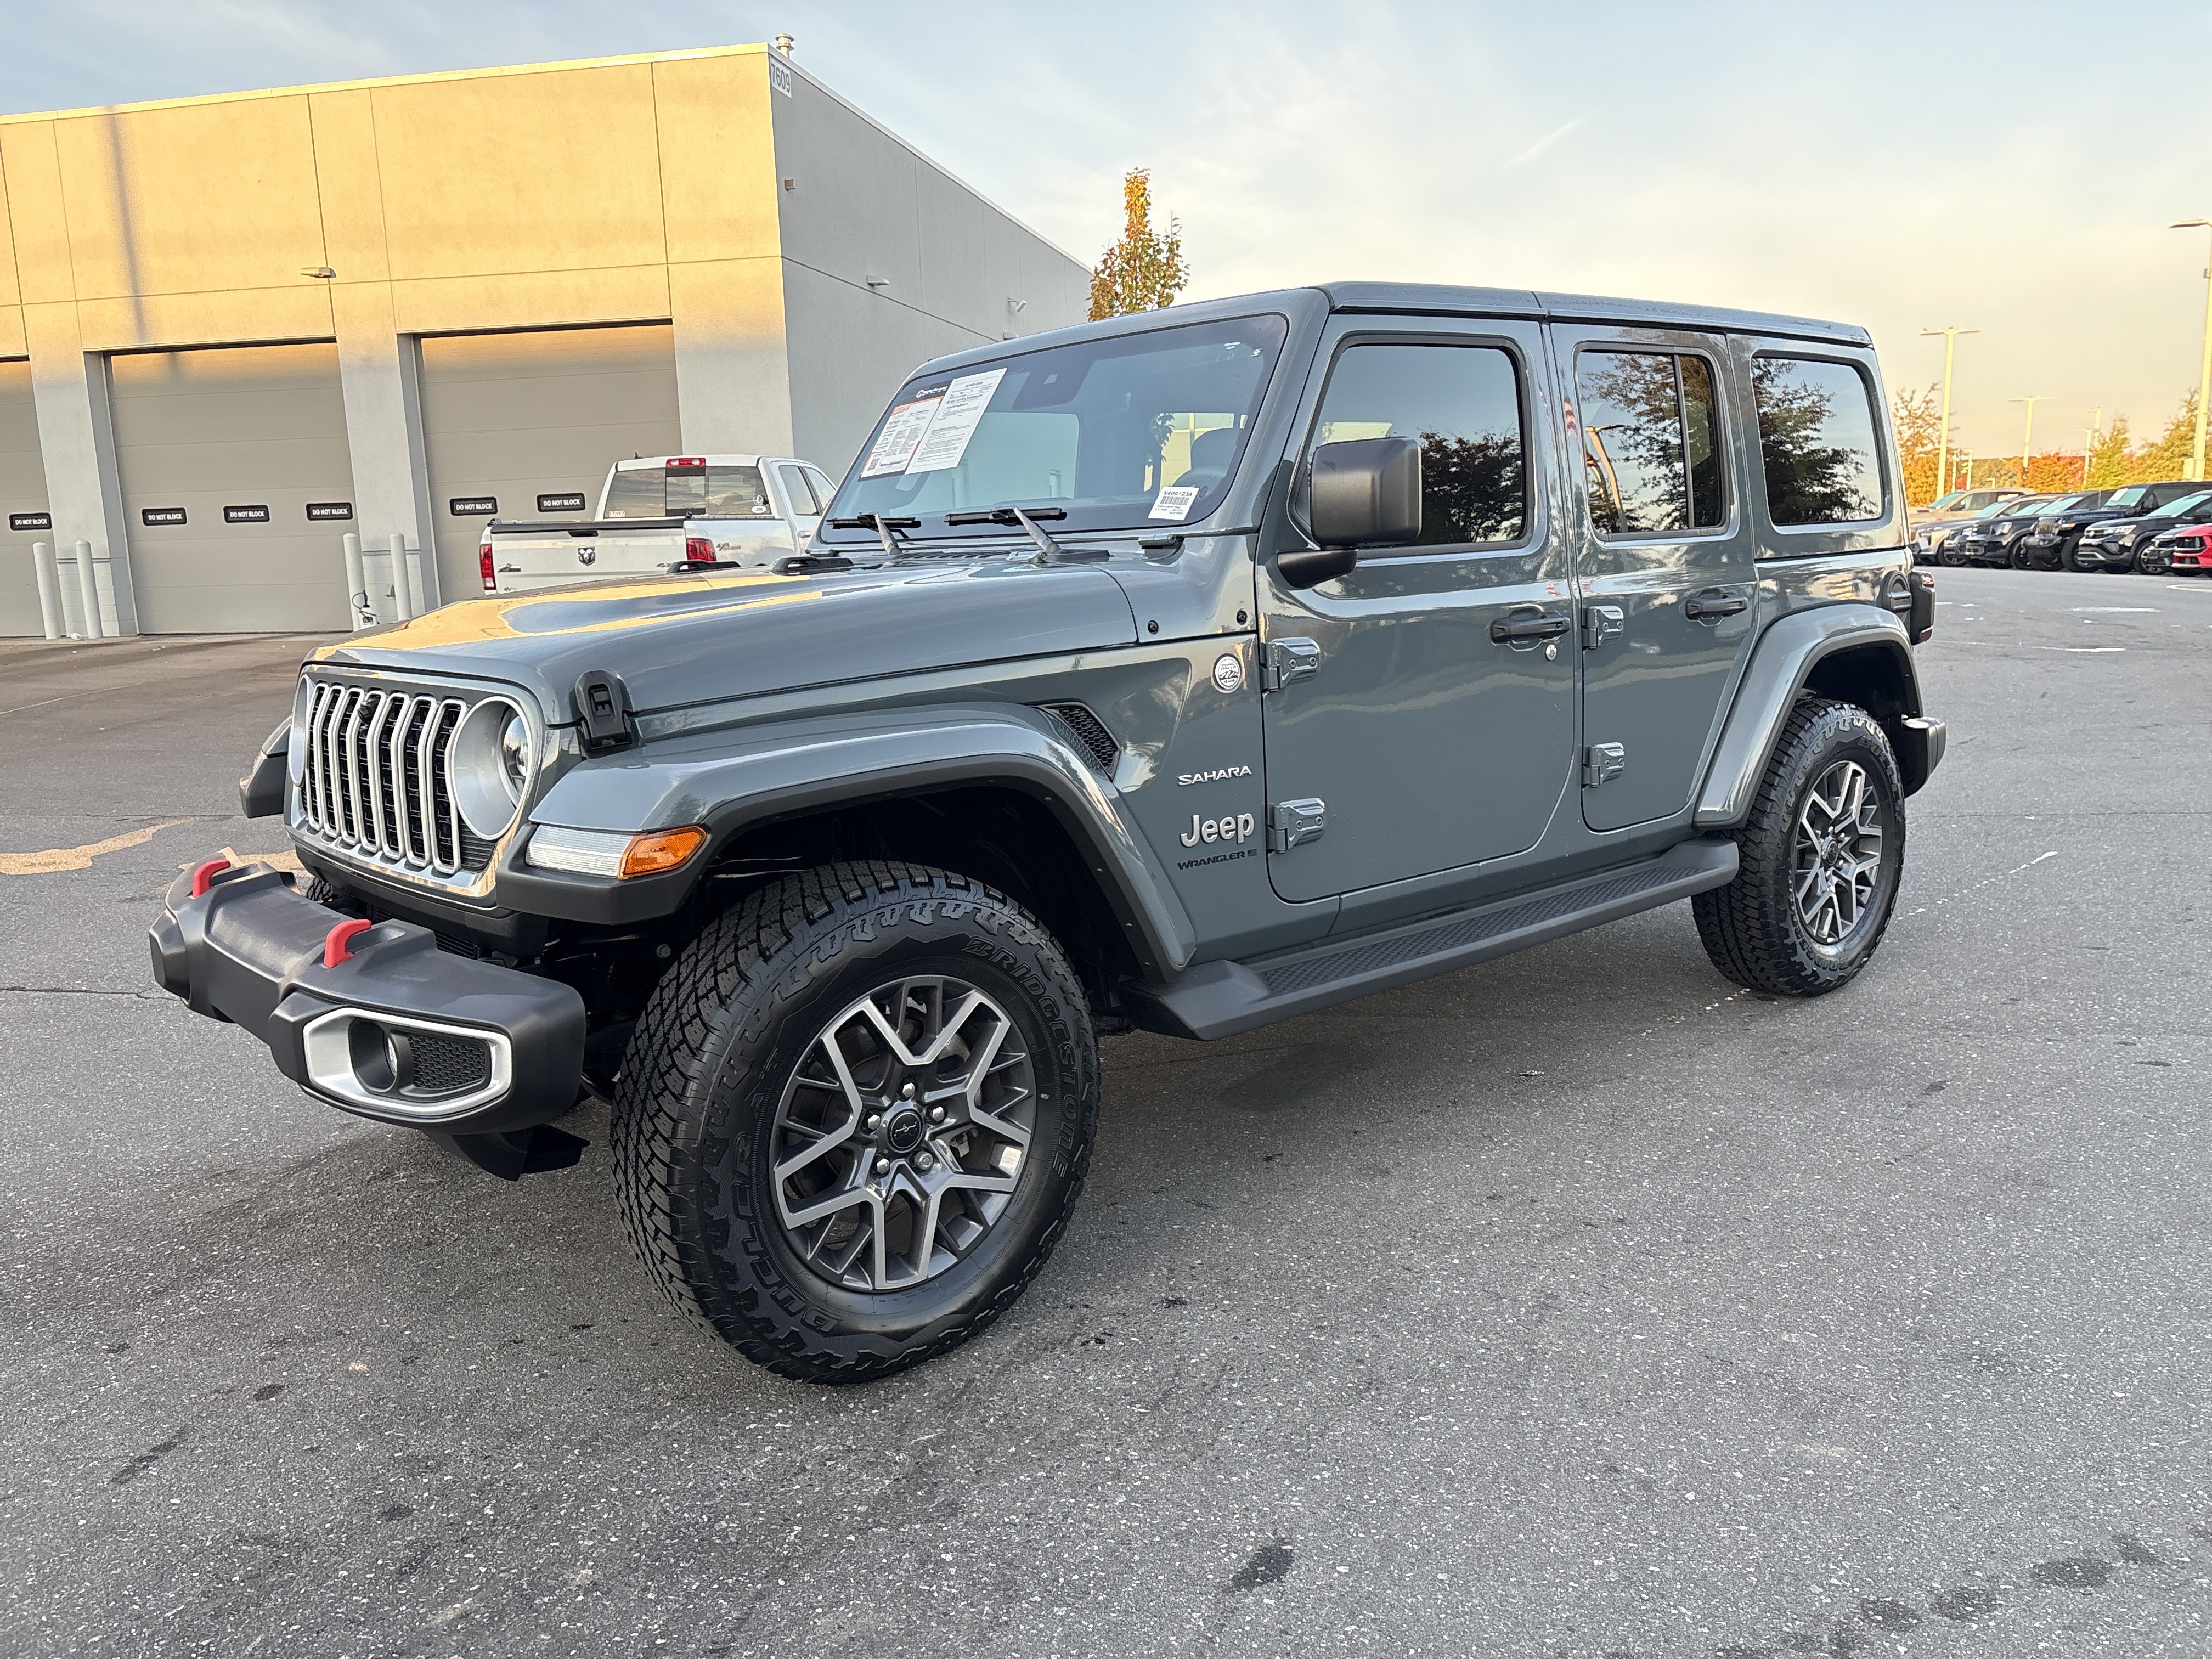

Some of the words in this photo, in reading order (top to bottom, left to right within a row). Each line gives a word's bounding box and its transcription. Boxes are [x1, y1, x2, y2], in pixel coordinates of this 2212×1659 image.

[771, 63, 791, 93] 7609
[1177, 765, 1253, 786] SAHARA
[1180, 812, 1255, 848] Jeep
[1177, 851, 1246, 870] WRANGLER
[960, 935, 1079, 1180] BRIDGESTONE
[732, 1131, 843, 1334] DUELER
